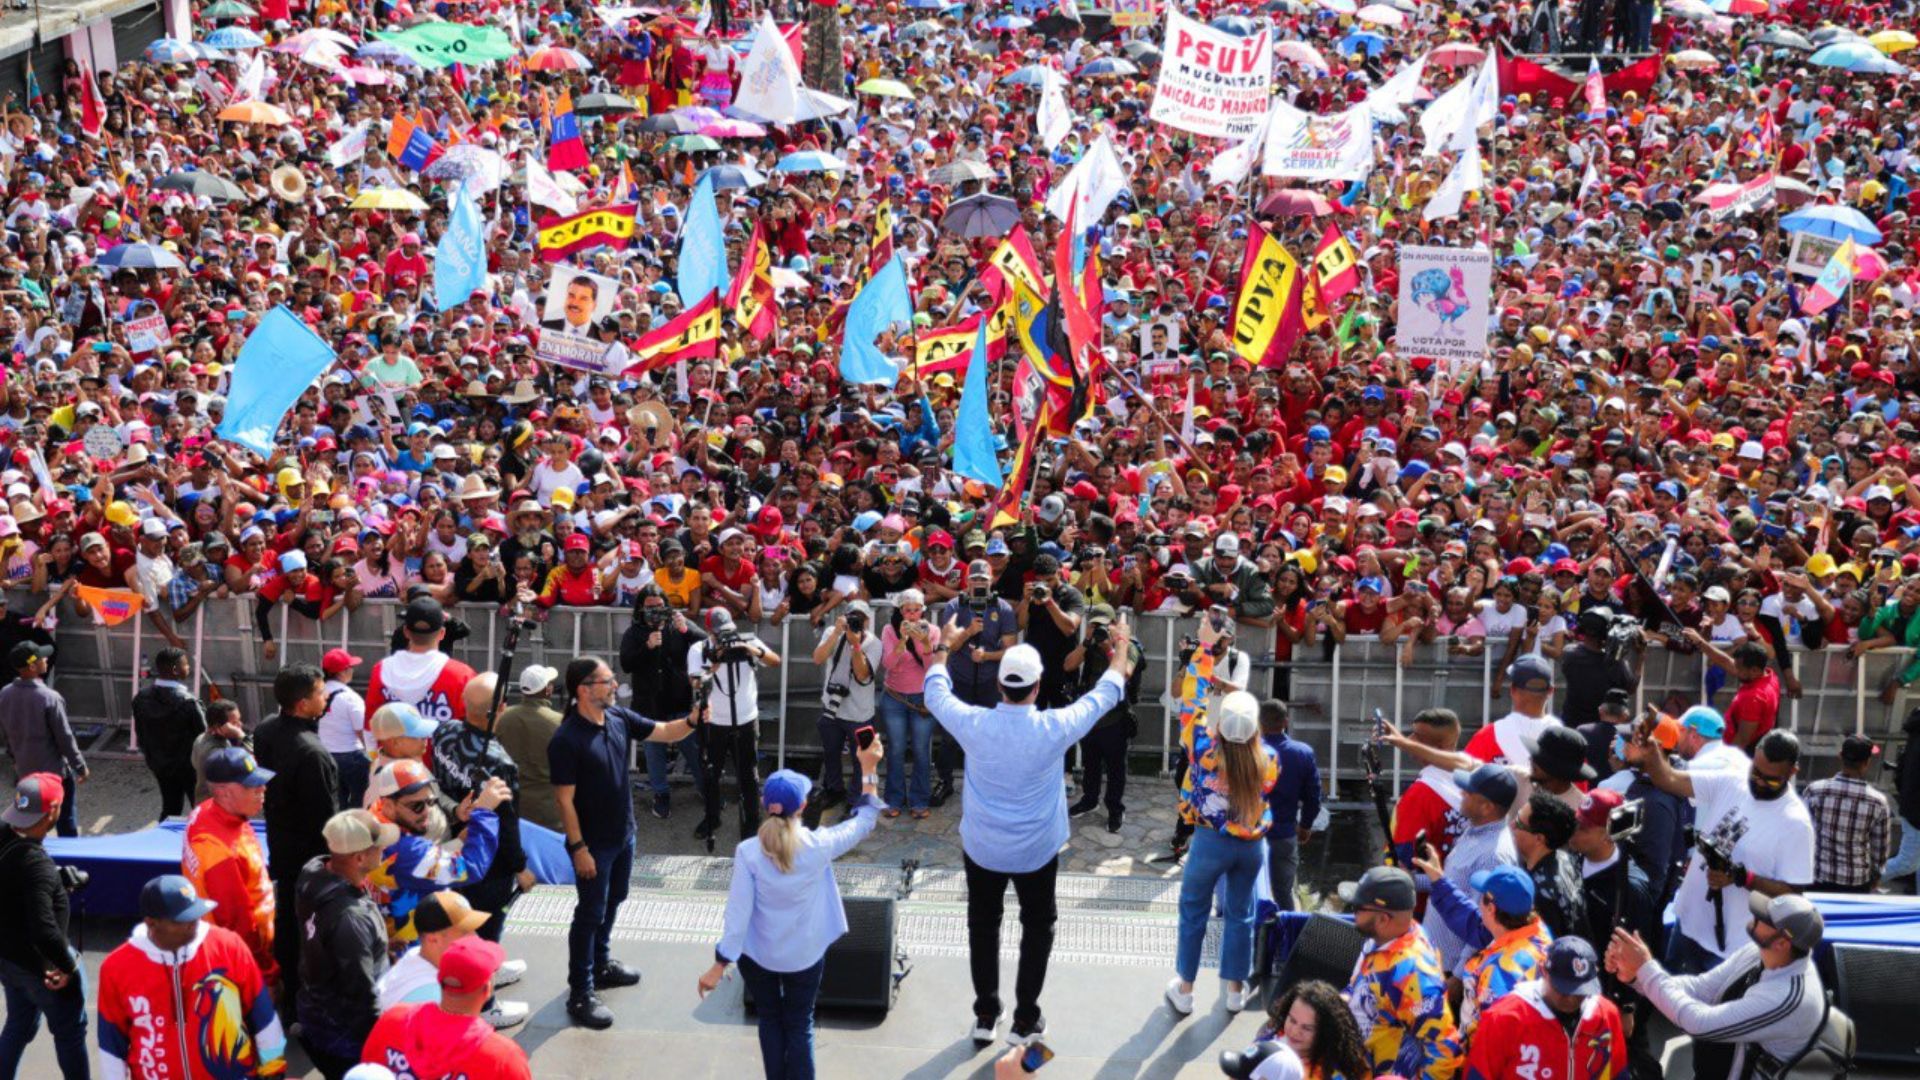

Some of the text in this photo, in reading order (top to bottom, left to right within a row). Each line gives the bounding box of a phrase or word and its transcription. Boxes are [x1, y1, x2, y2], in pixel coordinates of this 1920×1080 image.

[1176, 29, 1267, 74] PSUV
[1161, 84, 1267, 114] NICOLAS MADURO
[1412, 337, 1466, 347] VOTA POR
